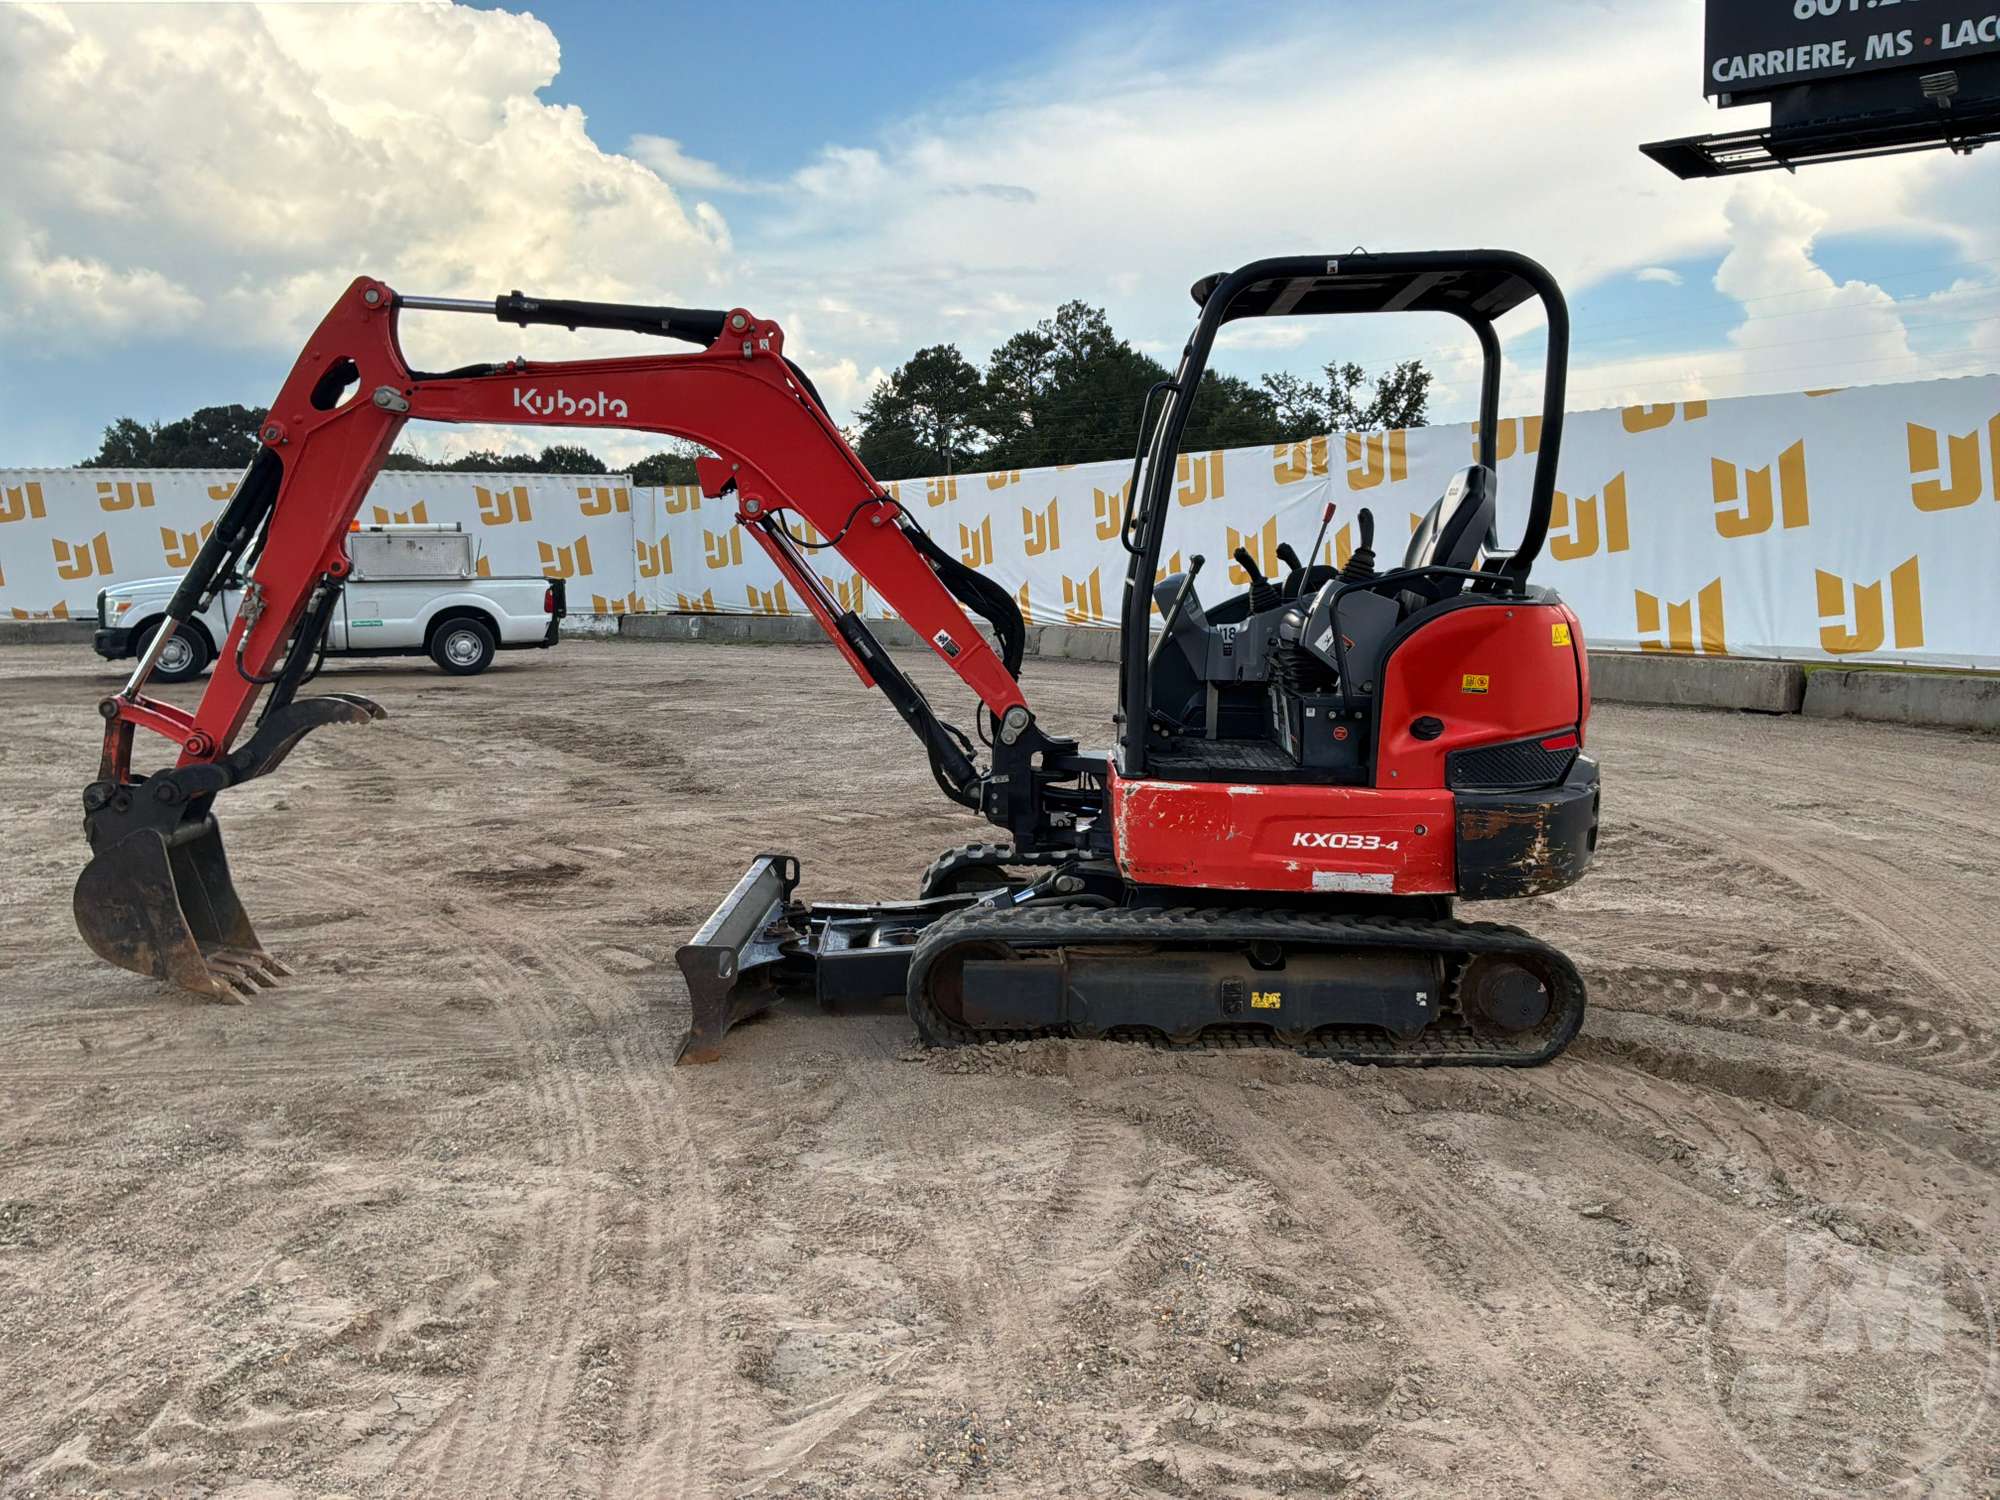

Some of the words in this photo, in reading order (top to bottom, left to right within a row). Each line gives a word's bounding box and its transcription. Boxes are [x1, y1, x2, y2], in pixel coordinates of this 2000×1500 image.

[1712, 40, 1856, 82] CARRIERE,
[1865, 29, 1913, 61] MS
[1941, 15, 2000, 50] LAC
[512, 387, 629, 418] Kubota
[1291, 832, 1399, 851] KX033-4
